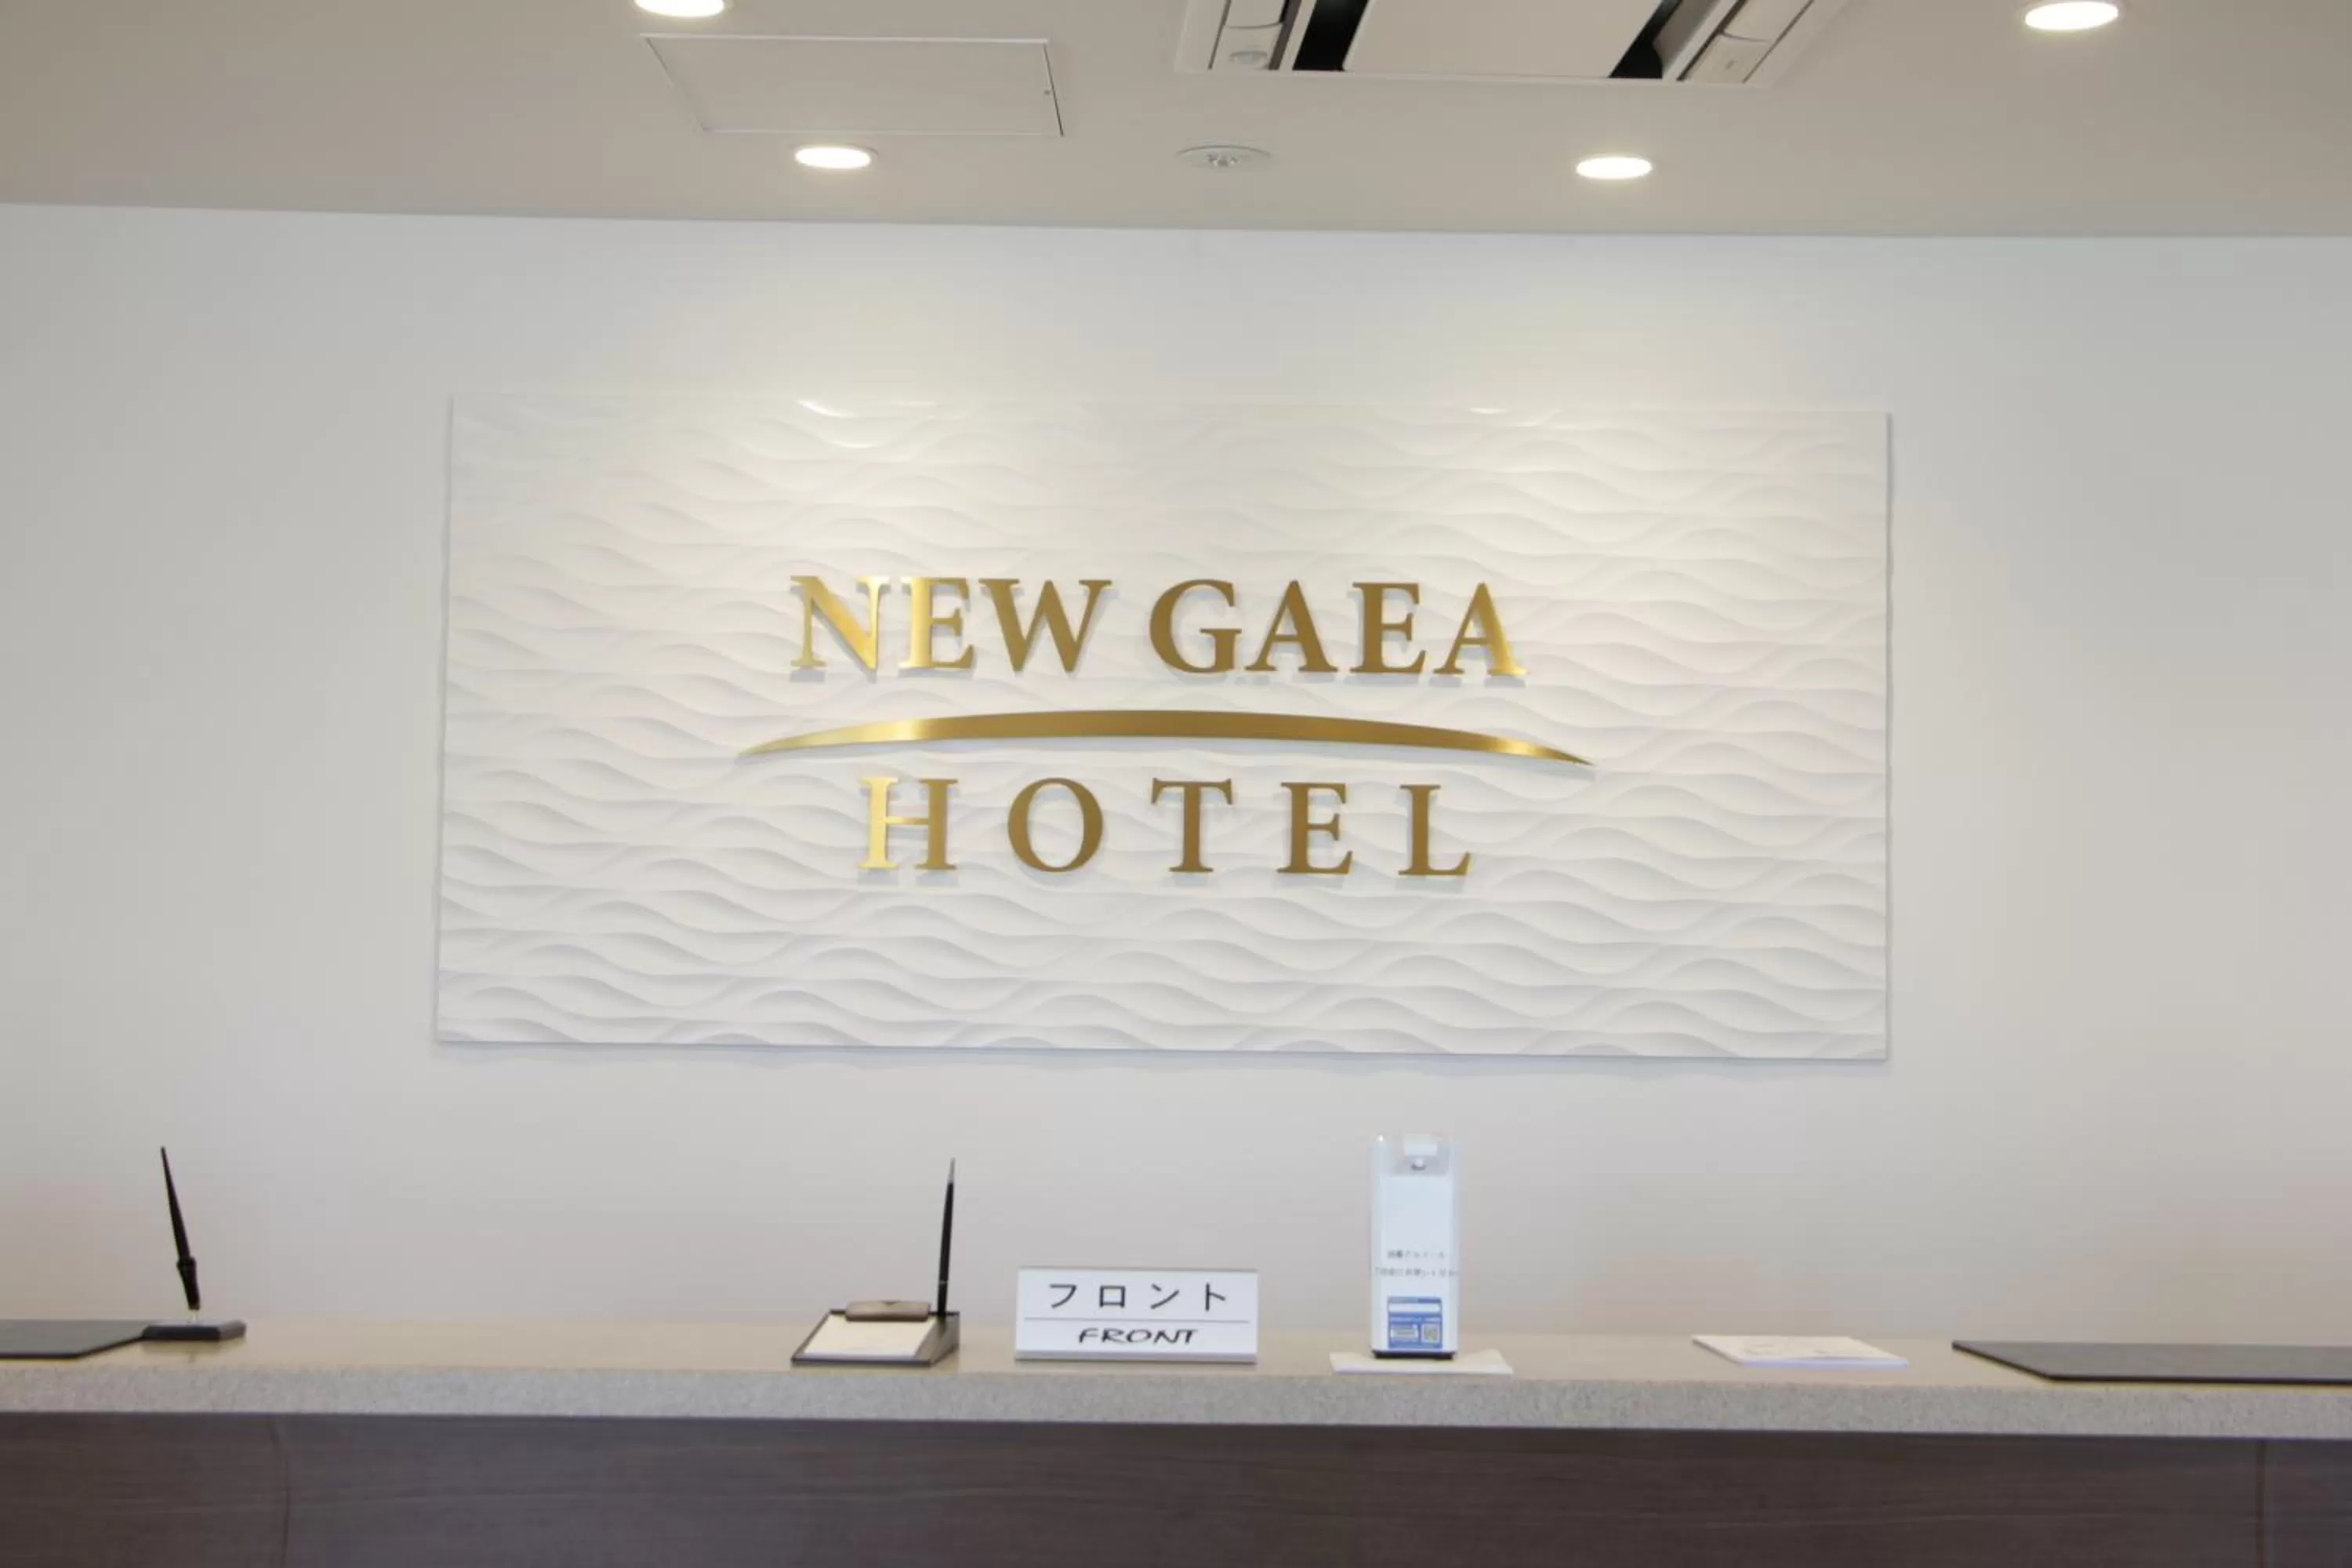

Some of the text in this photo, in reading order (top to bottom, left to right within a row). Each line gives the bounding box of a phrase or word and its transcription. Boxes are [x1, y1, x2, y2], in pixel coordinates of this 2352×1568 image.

[790, 575, 1527, 677] NEW GAEA
[858, 777, 1471, 877] HOTEL
[1049, 1282, 1226, 1312] フロント
[1079, 1327, 1198, 1345] FRONT
